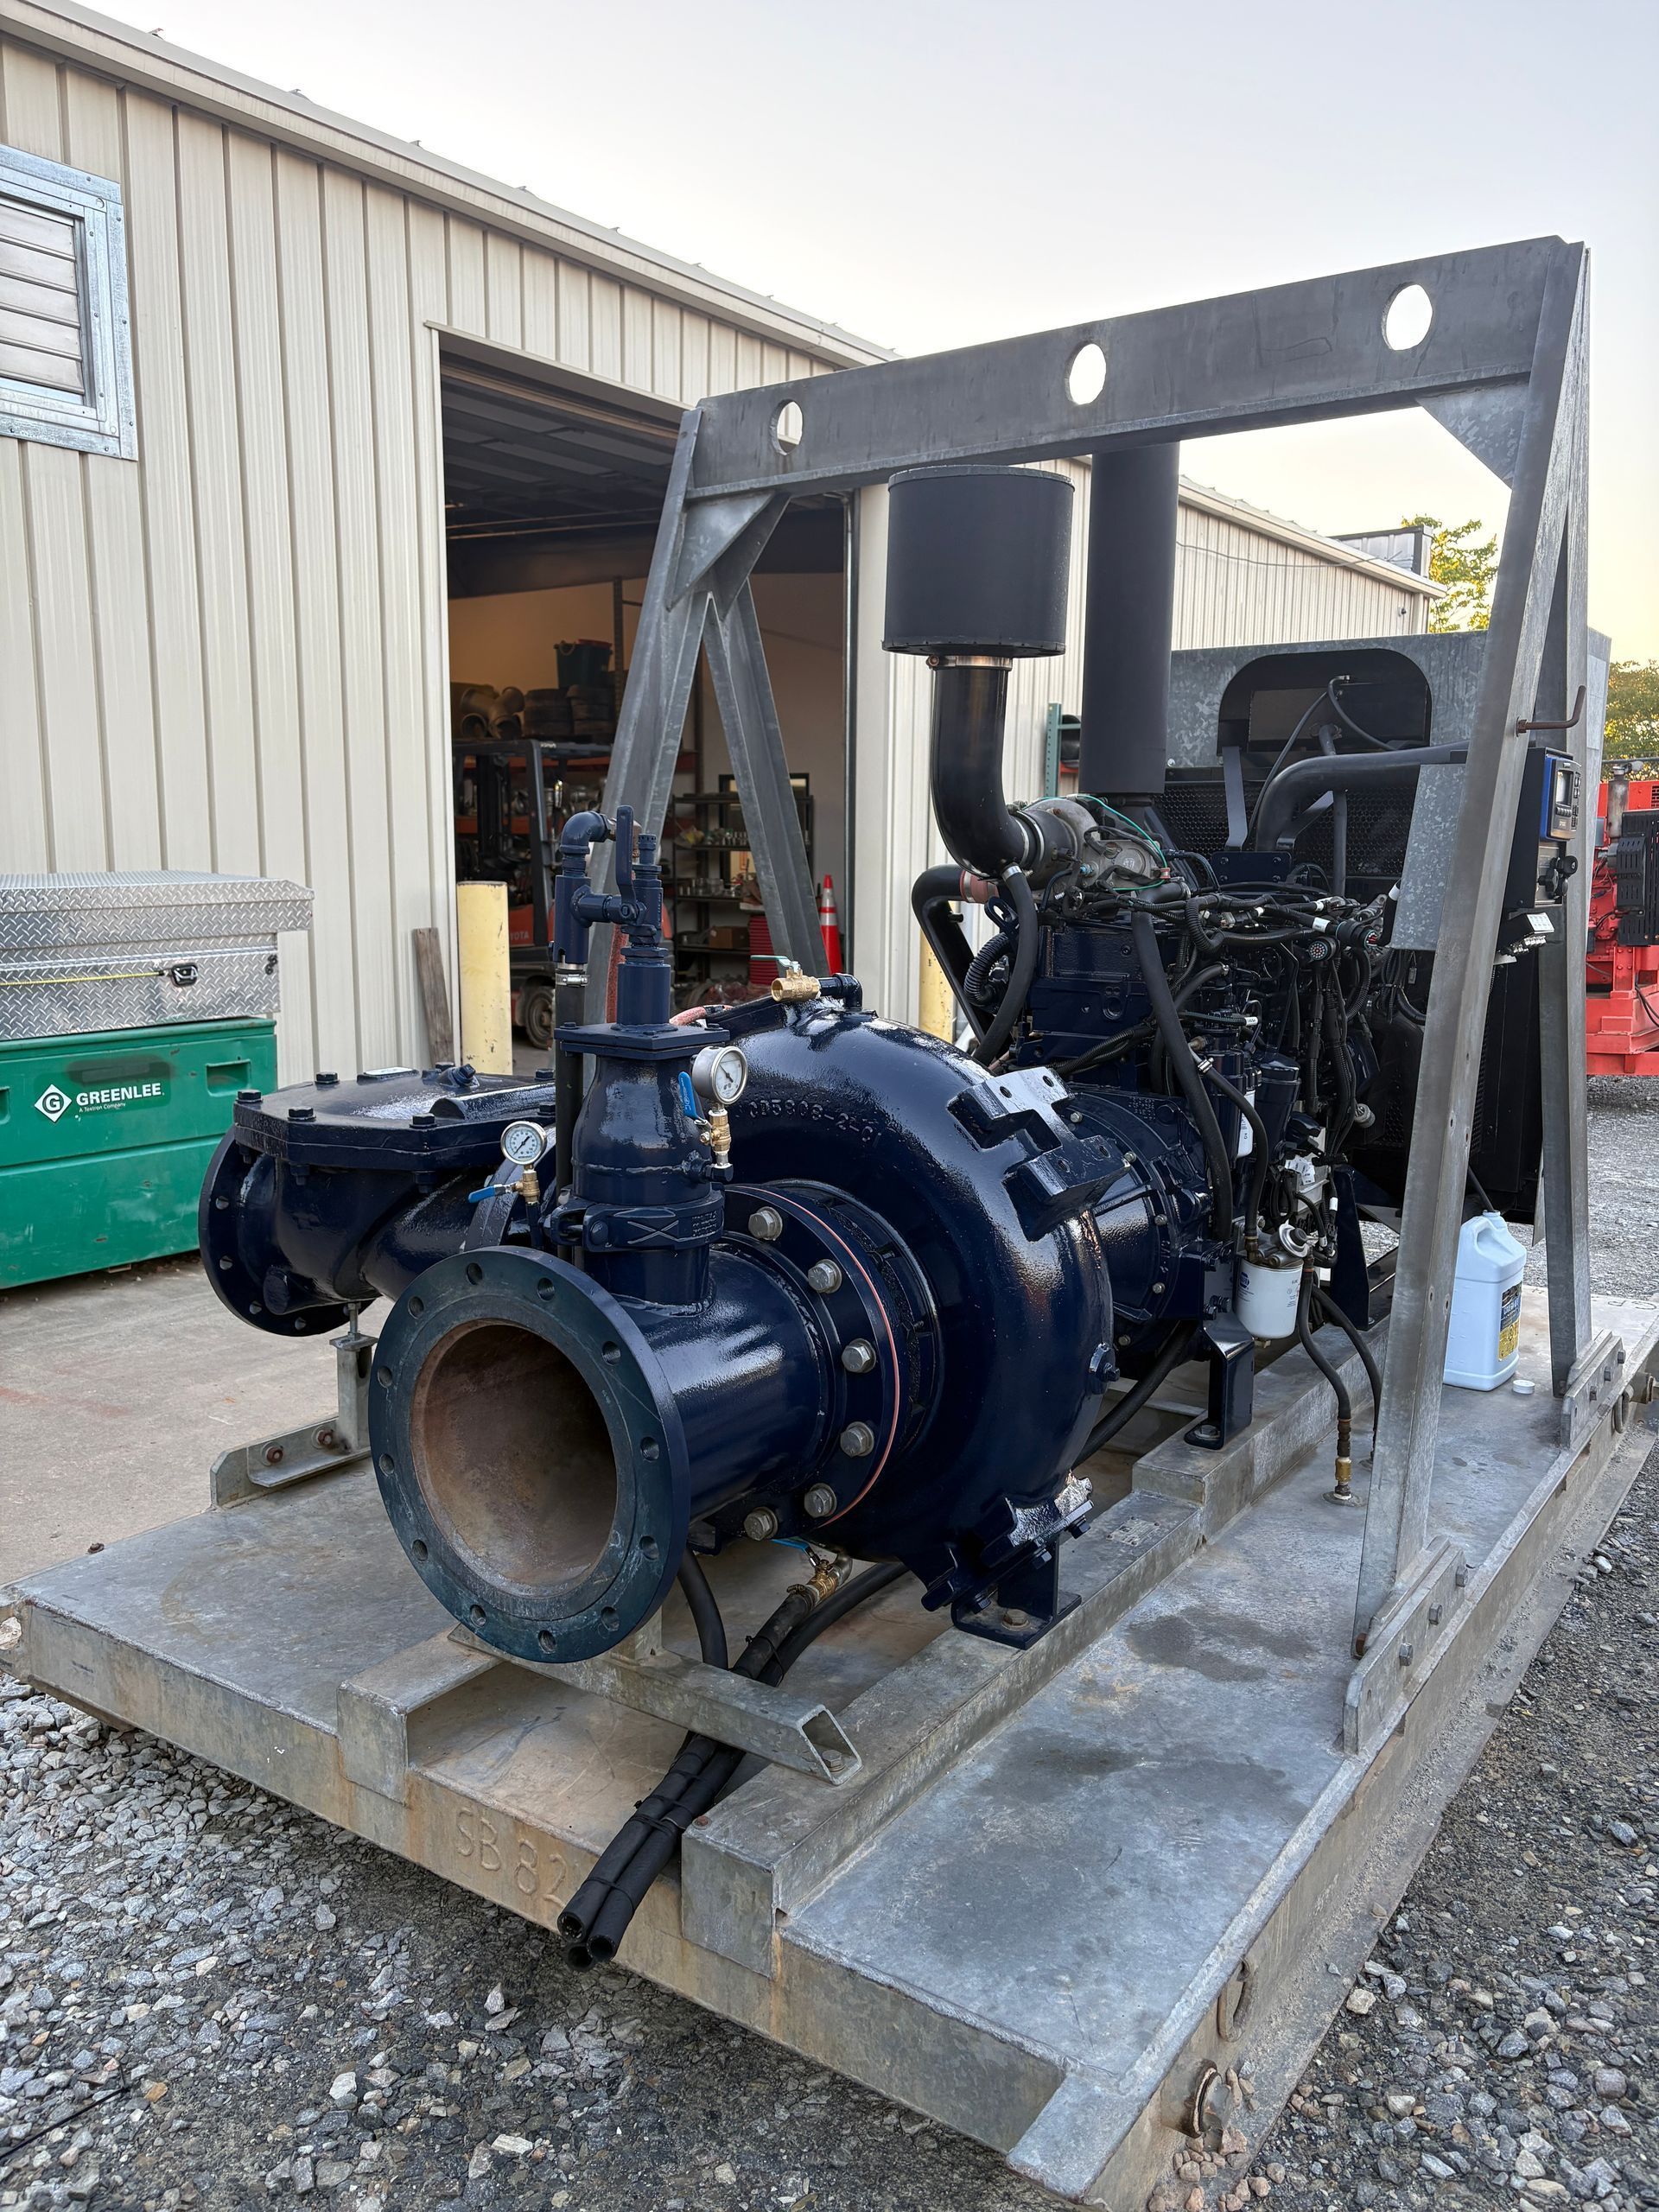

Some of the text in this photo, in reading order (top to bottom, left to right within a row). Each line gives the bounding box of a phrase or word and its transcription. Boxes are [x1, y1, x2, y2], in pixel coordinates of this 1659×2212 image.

[510, 931, 530, 941] YOTA
[76, 1083, 162, 1106] GREENLEE
[104, 1102, 126, 1110] Company
[456, 1806, 502, 1872] SB
